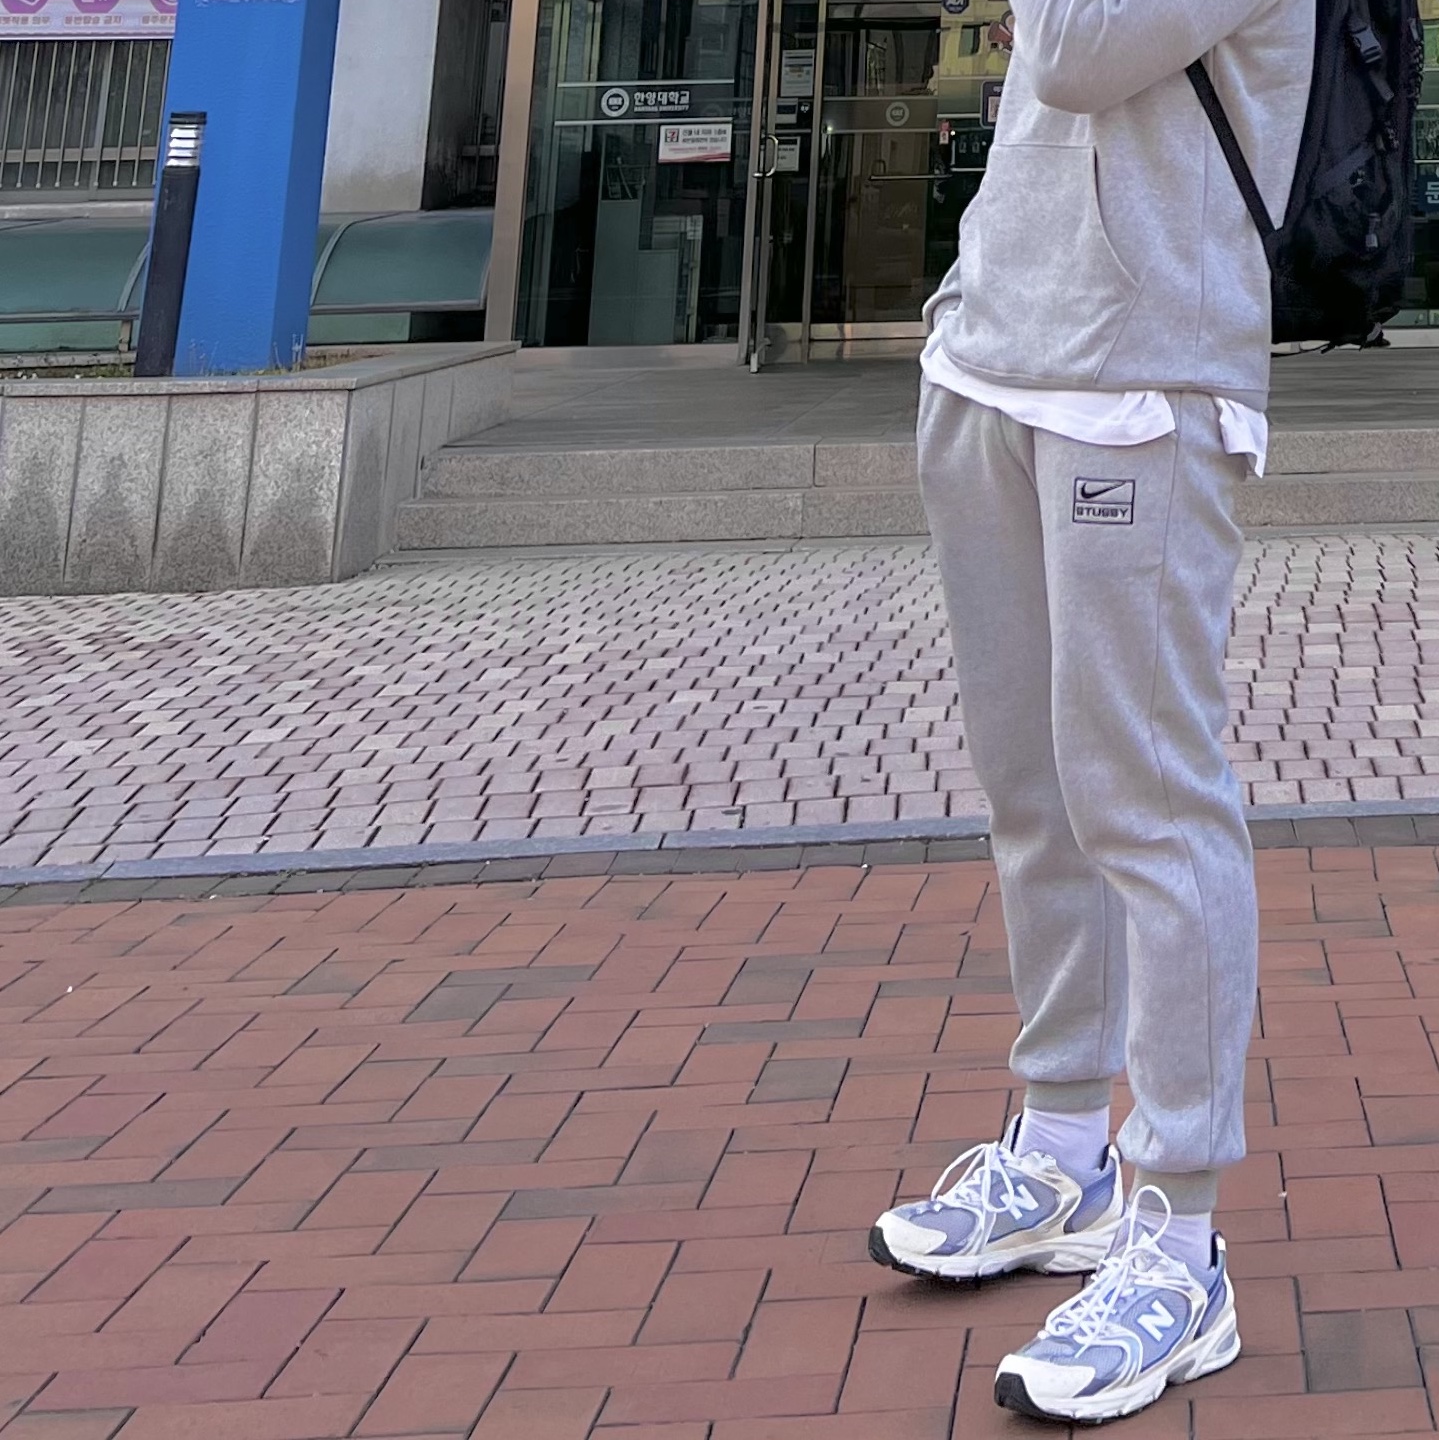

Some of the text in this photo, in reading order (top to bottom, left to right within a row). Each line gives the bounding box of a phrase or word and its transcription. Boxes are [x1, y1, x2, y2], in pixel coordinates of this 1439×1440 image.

[633, 91, 690, 106] 한양대학교
[999, 1183, 1039, 1220] N
[1137, 1299, 1176, 1342] N
